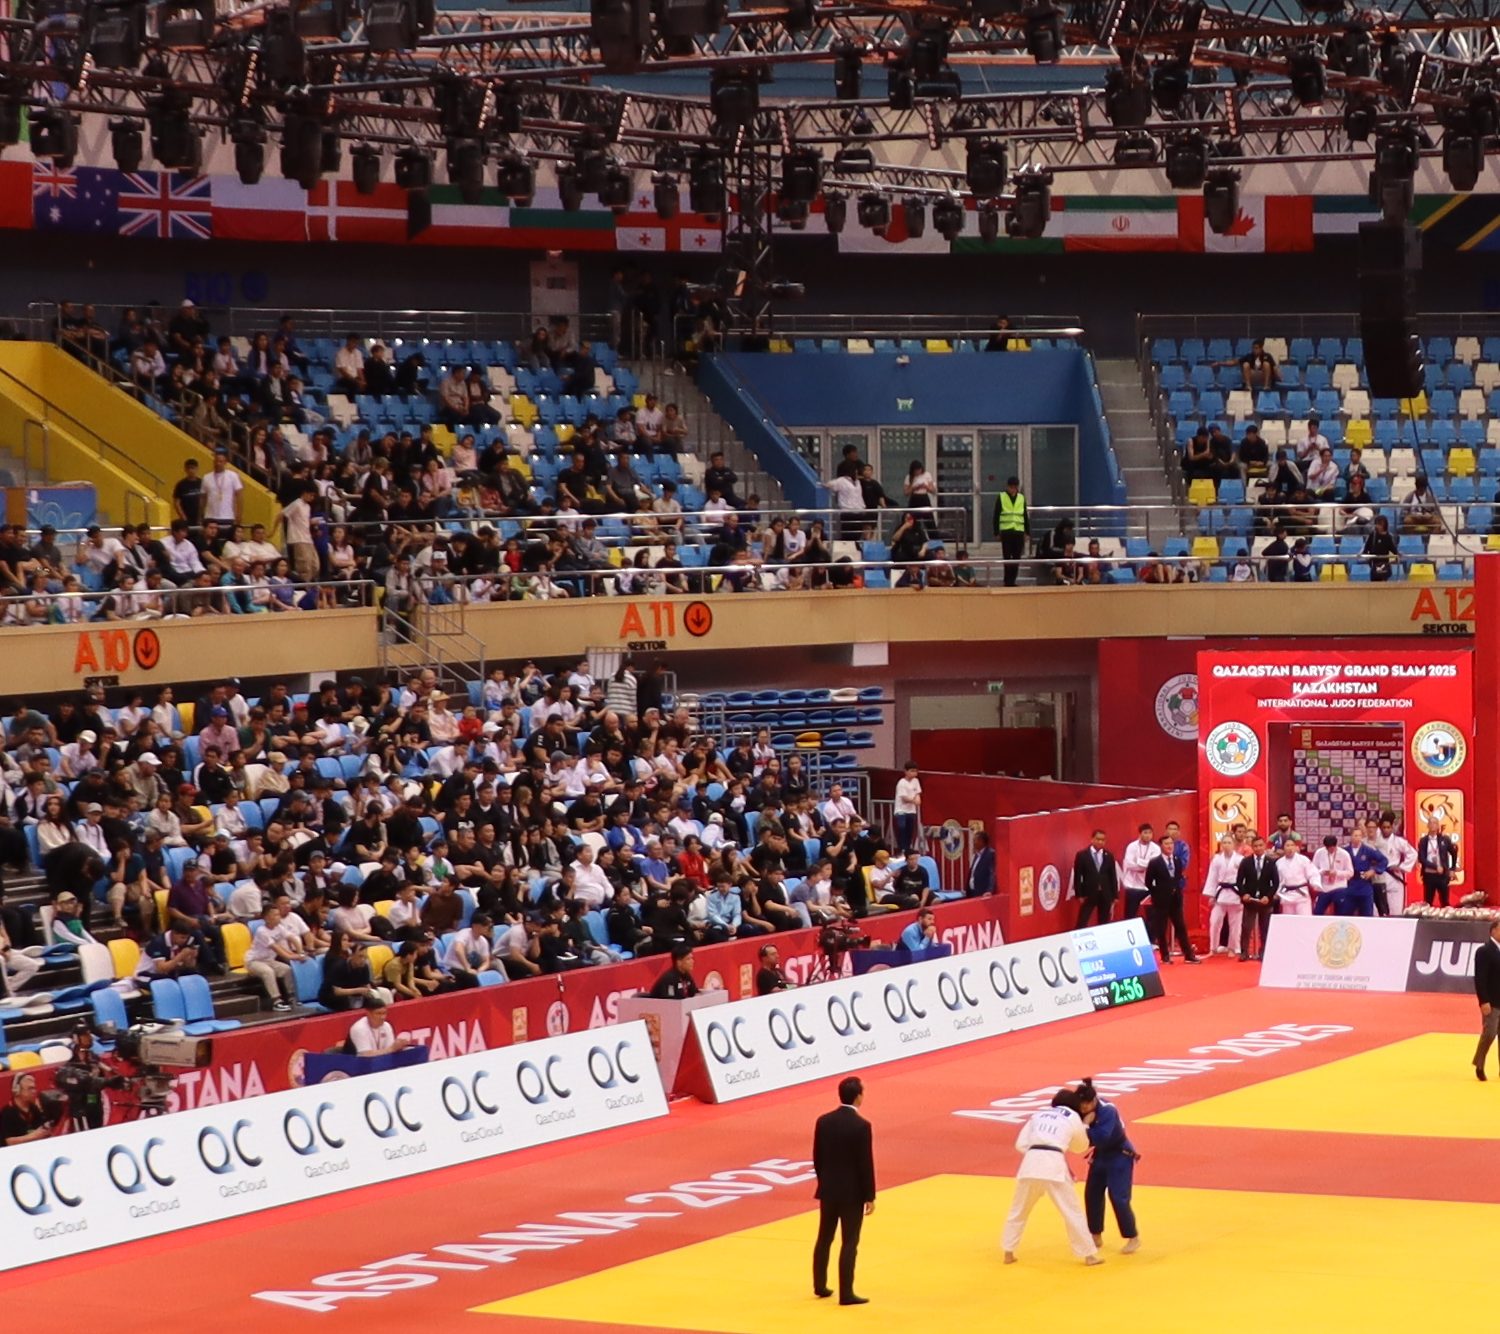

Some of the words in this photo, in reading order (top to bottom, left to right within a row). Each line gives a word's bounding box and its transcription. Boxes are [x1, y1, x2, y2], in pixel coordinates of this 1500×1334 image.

[1423, 623, 1468, 633] SEKTOR
[1213, 665, 1290, 677] QAZAQSTAN
[1293, 665, 1341, 676] BARYSY
[1344, 665, 1388, 676] GRAND
[1391, 666, 1426, 676] SLAM
[1429, 666, 1456, 676] 2025
[1293, 683, 1378, 693] KAZAKHSTAN
[1258, 699, 1328, 708] INTERNATIONAL
[1330, 699, 1355, 708] JUDO
[1357, 699, 1412, 708] FEDERATION
[1111, 977, 1144, 1003] 2:56
[1183, 1021, 1353, 1058] 2025
[251, 1209, 682, 1313] ASTANA
